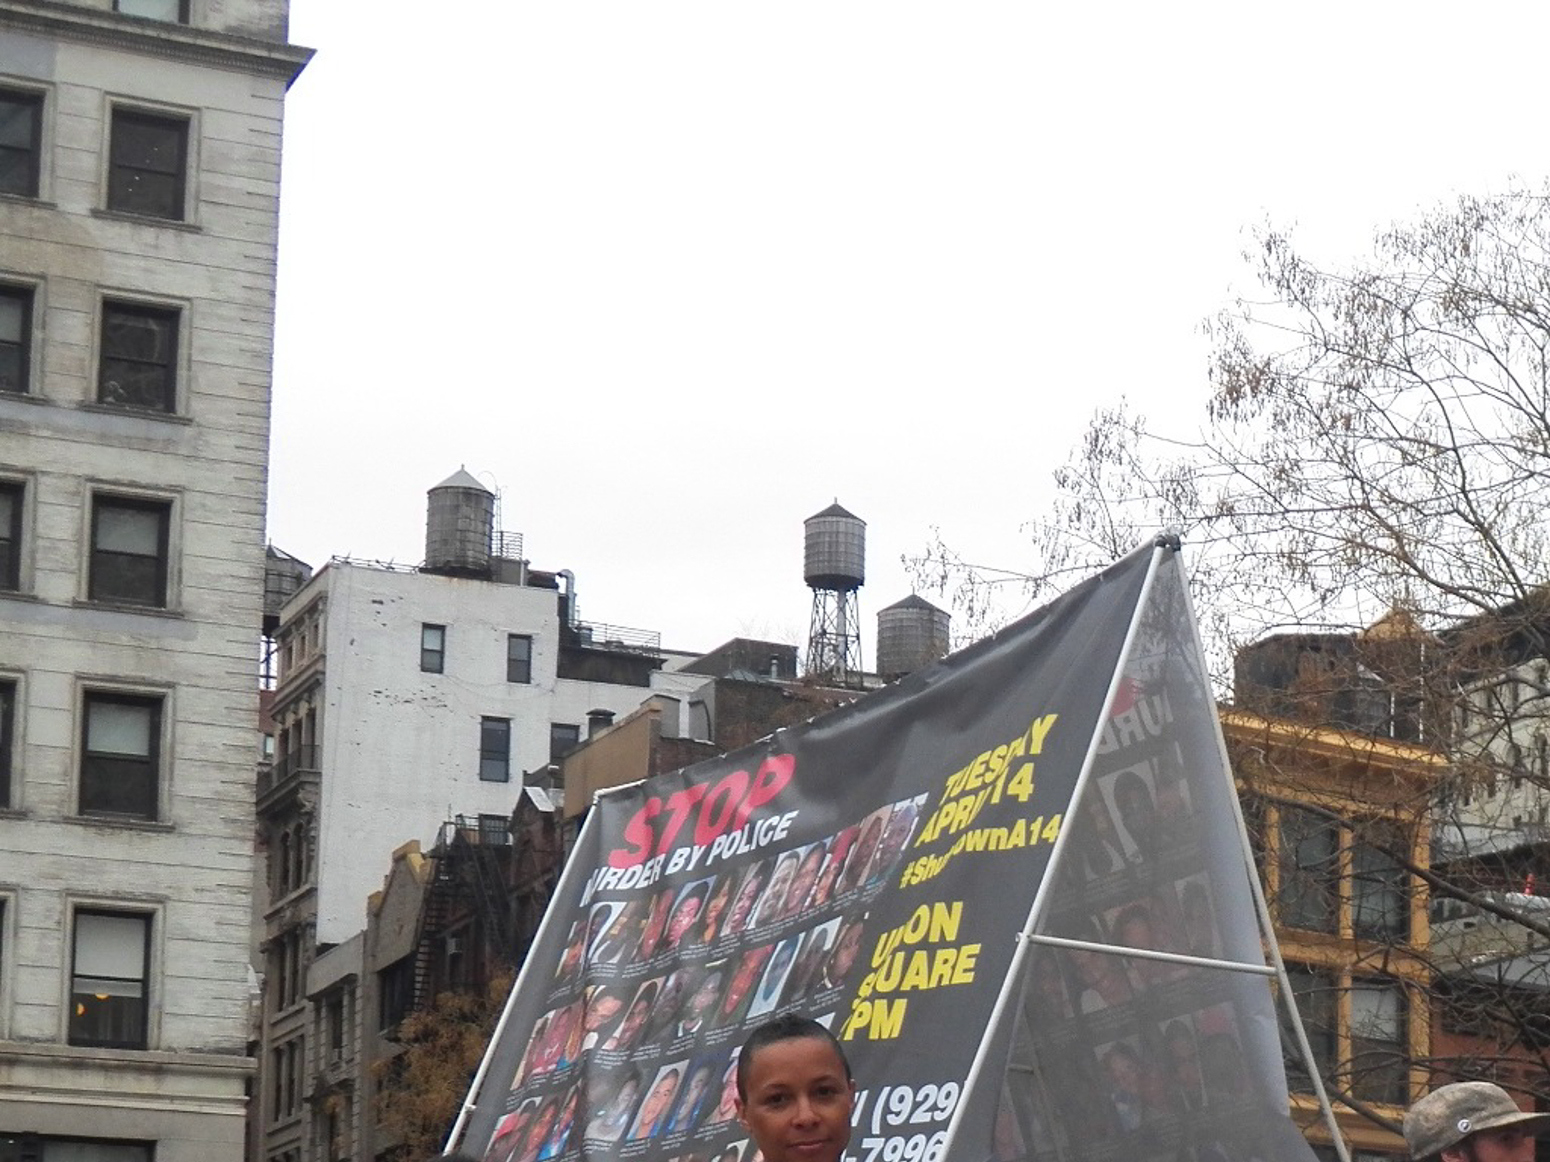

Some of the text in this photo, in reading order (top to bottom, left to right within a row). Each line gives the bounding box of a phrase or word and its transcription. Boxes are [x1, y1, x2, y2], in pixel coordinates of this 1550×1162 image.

[608, 753, 796, 869] STOP
[990, 763, 1035, 804] 14
[665, 845, 707, 876] BY
[706, 810, 800, 866] POLICE
[871, 901, 963, 968] UON
[858, 943, 982, 997] SUARE
